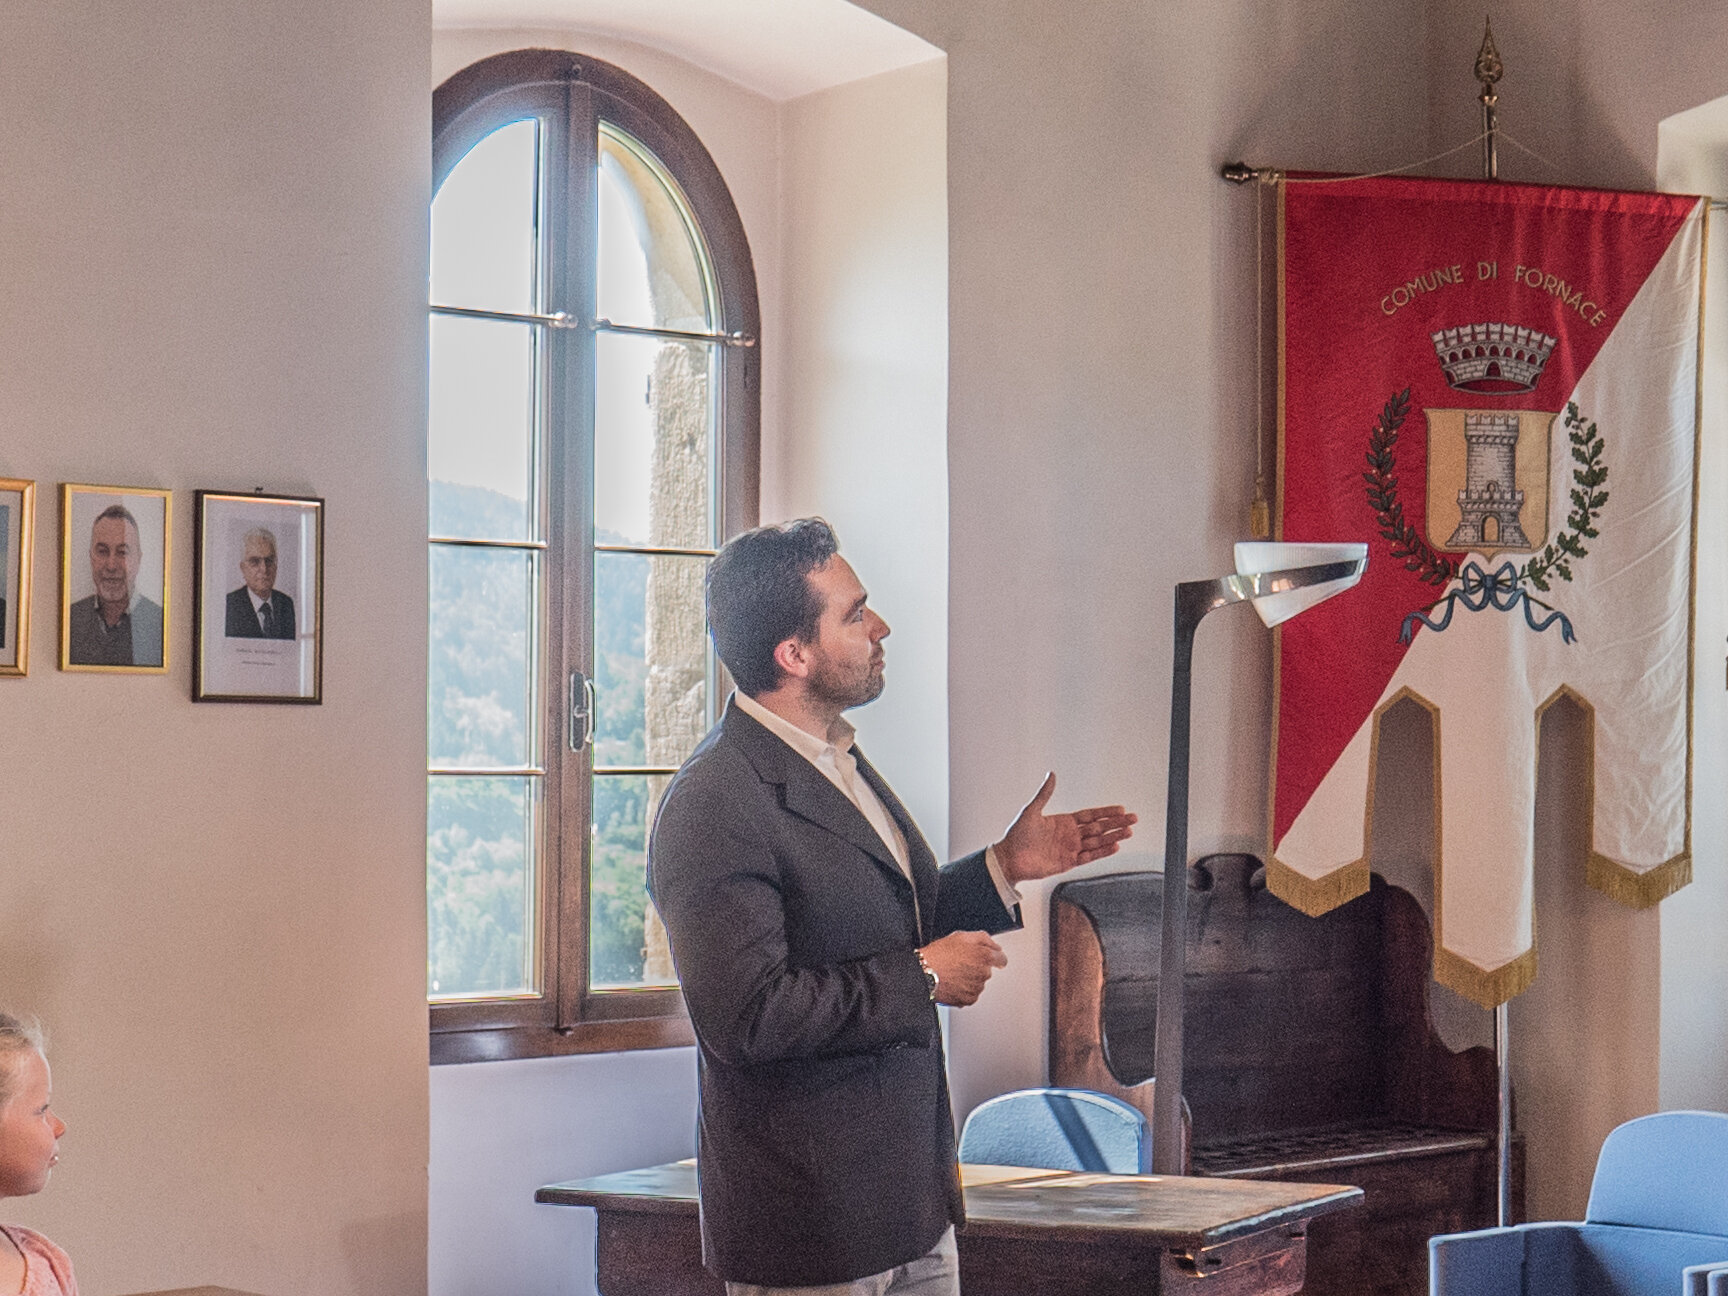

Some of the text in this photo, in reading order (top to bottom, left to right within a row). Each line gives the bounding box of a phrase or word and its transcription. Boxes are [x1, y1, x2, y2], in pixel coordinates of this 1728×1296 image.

[1381, 261, 1607, 328] COMUNE DI FORNACE
